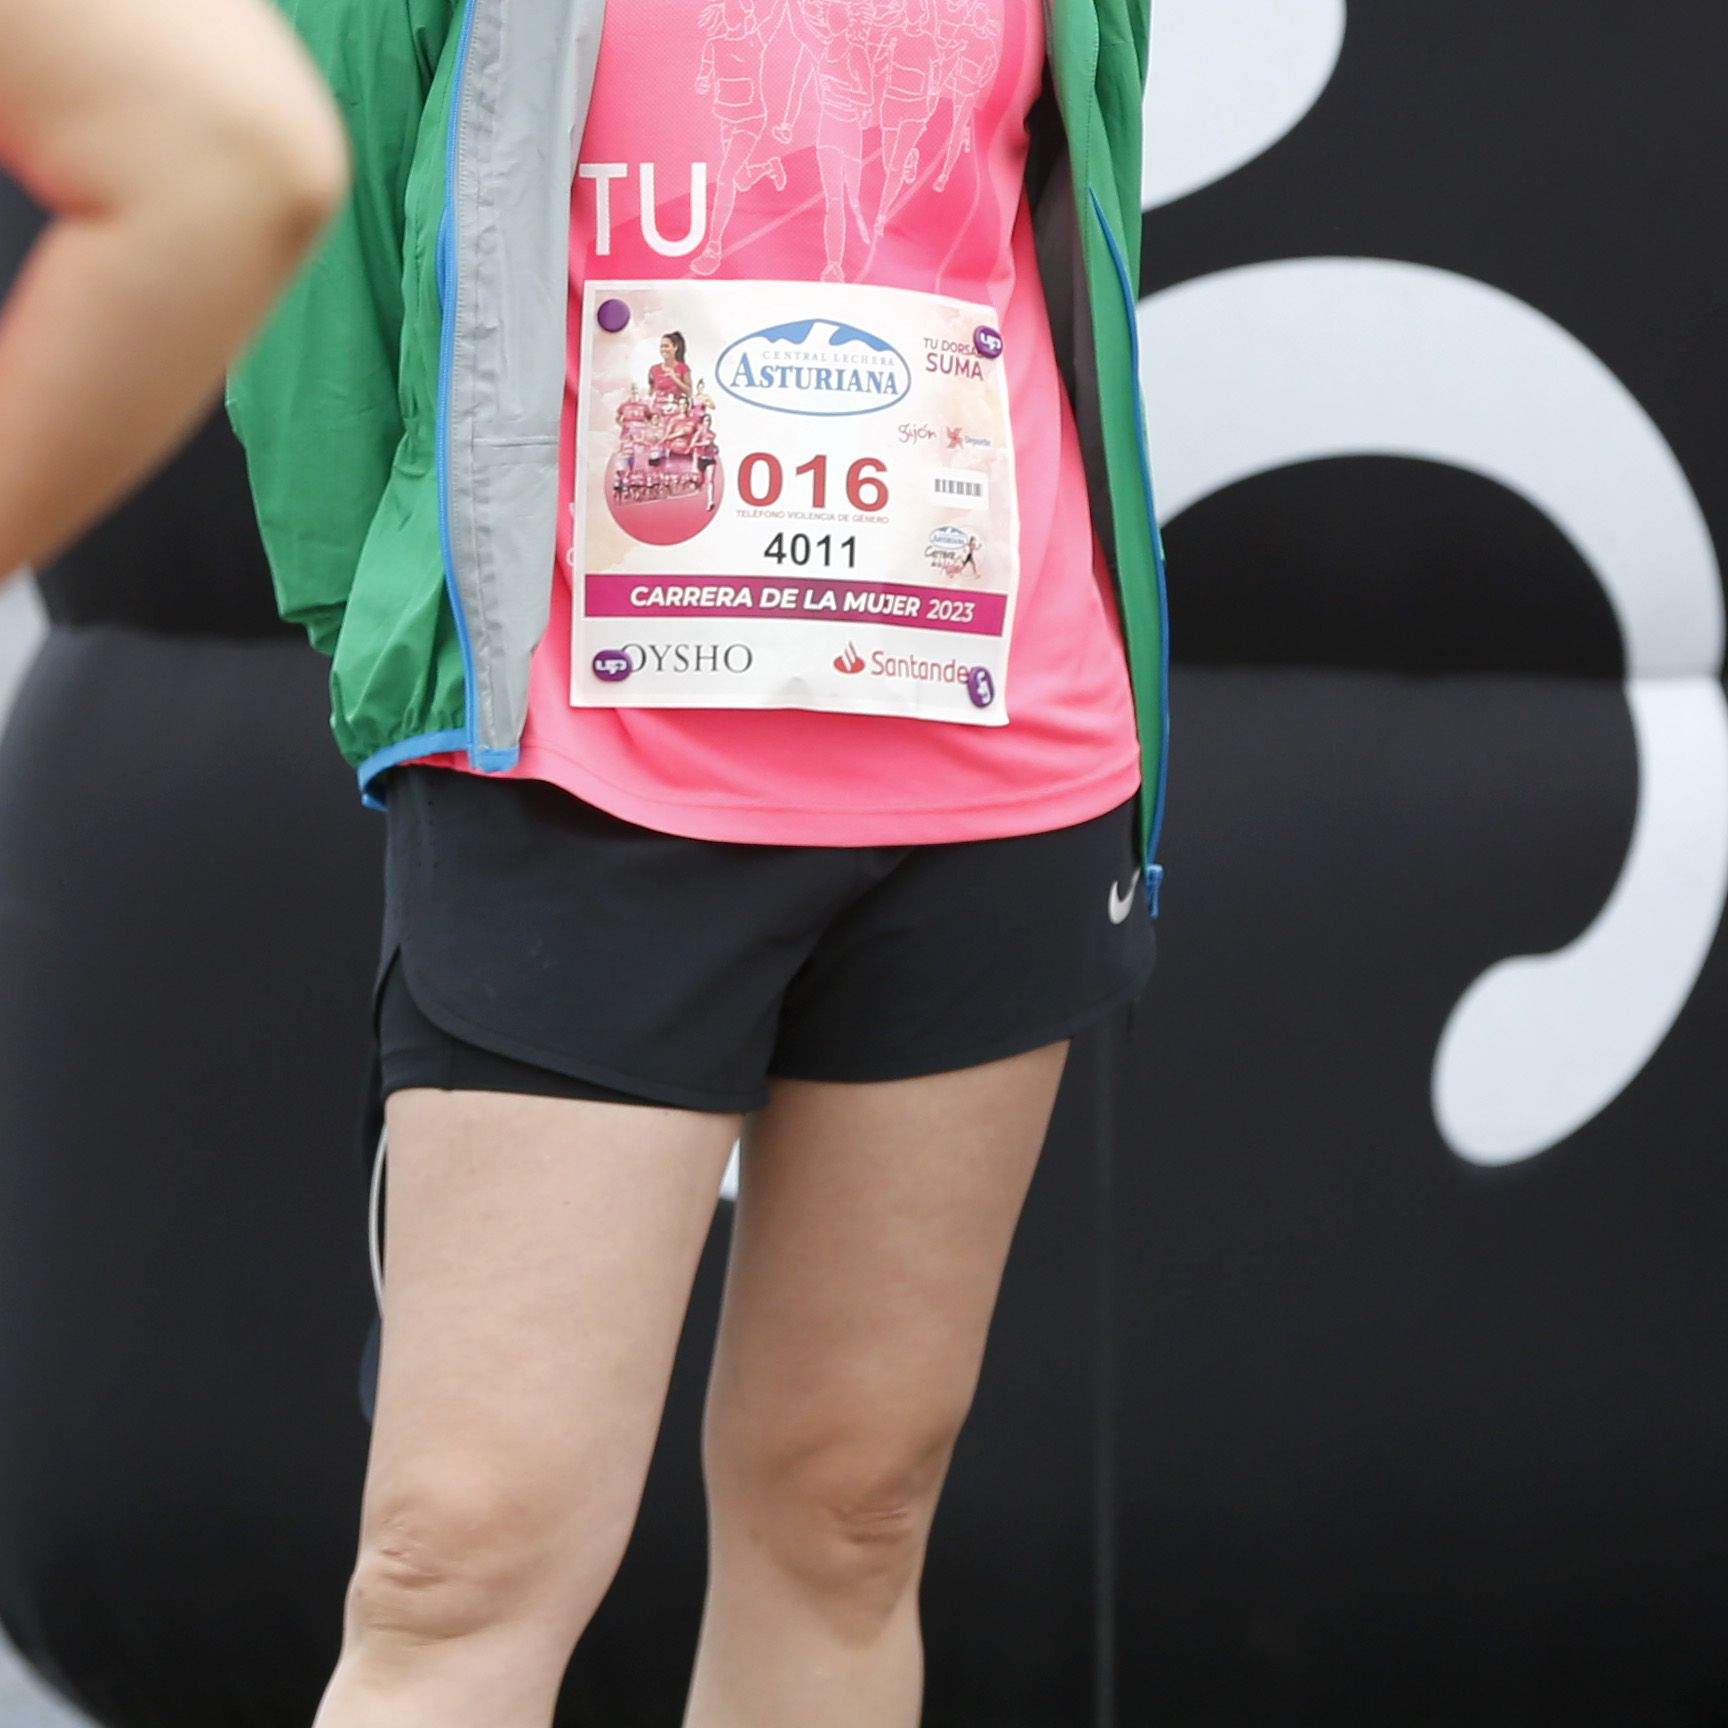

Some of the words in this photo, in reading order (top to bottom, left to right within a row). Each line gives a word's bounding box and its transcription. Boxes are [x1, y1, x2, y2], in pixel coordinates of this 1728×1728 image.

[579, 162, 706, 257] TU
[762, 350, 826, 362] CENTRAL
[833, 353, 897, 367] LECHERA
[923, 336, 939, 350] TU
[941, 339, 984, 359] DORS
[730, 352, 899, 395] ASTURIANA
[926, 352, 984, 381] SUMA
[737, 451, 890, 512] 016
[837, 514, 850, 523] DE
[763, 532, 856, 568] 4011
[630, 585, 754, 608] CARRERA
[759, 587, 800, 609] DE
[803, 589, 837, 611] LA
[843, 591, 922, 617] MUJER
[926, 598, 976, 623] 2023
[871, 651, 970, 685] Santande
